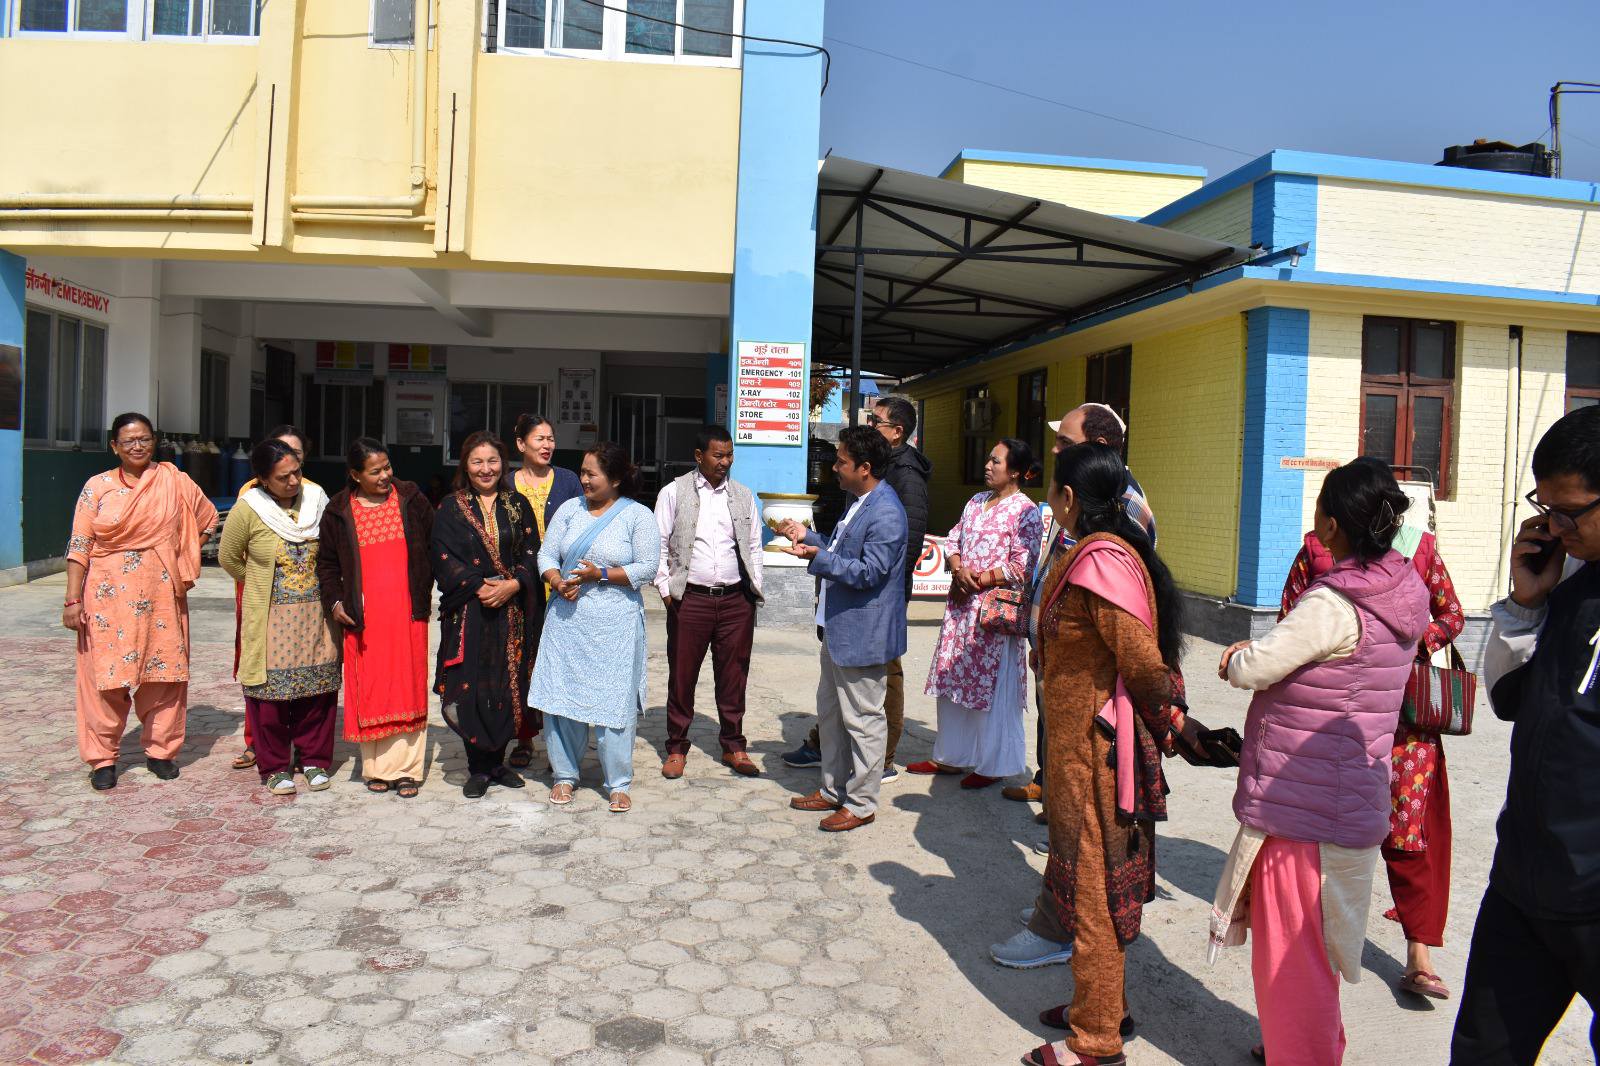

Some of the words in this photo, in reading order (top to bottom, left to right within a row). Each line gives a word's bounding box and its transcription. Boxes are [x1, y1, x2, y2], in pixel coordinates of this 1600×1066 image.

[770, 346, 789, 355] तला
[741, 368, 784, 377] EMERGENCY
[740, 389, 761, 397] X-RAY
[786, 391, 801, 399] -102
[739, 410, 763, 419] STORE
[738, 432, 753, 440] LAB
